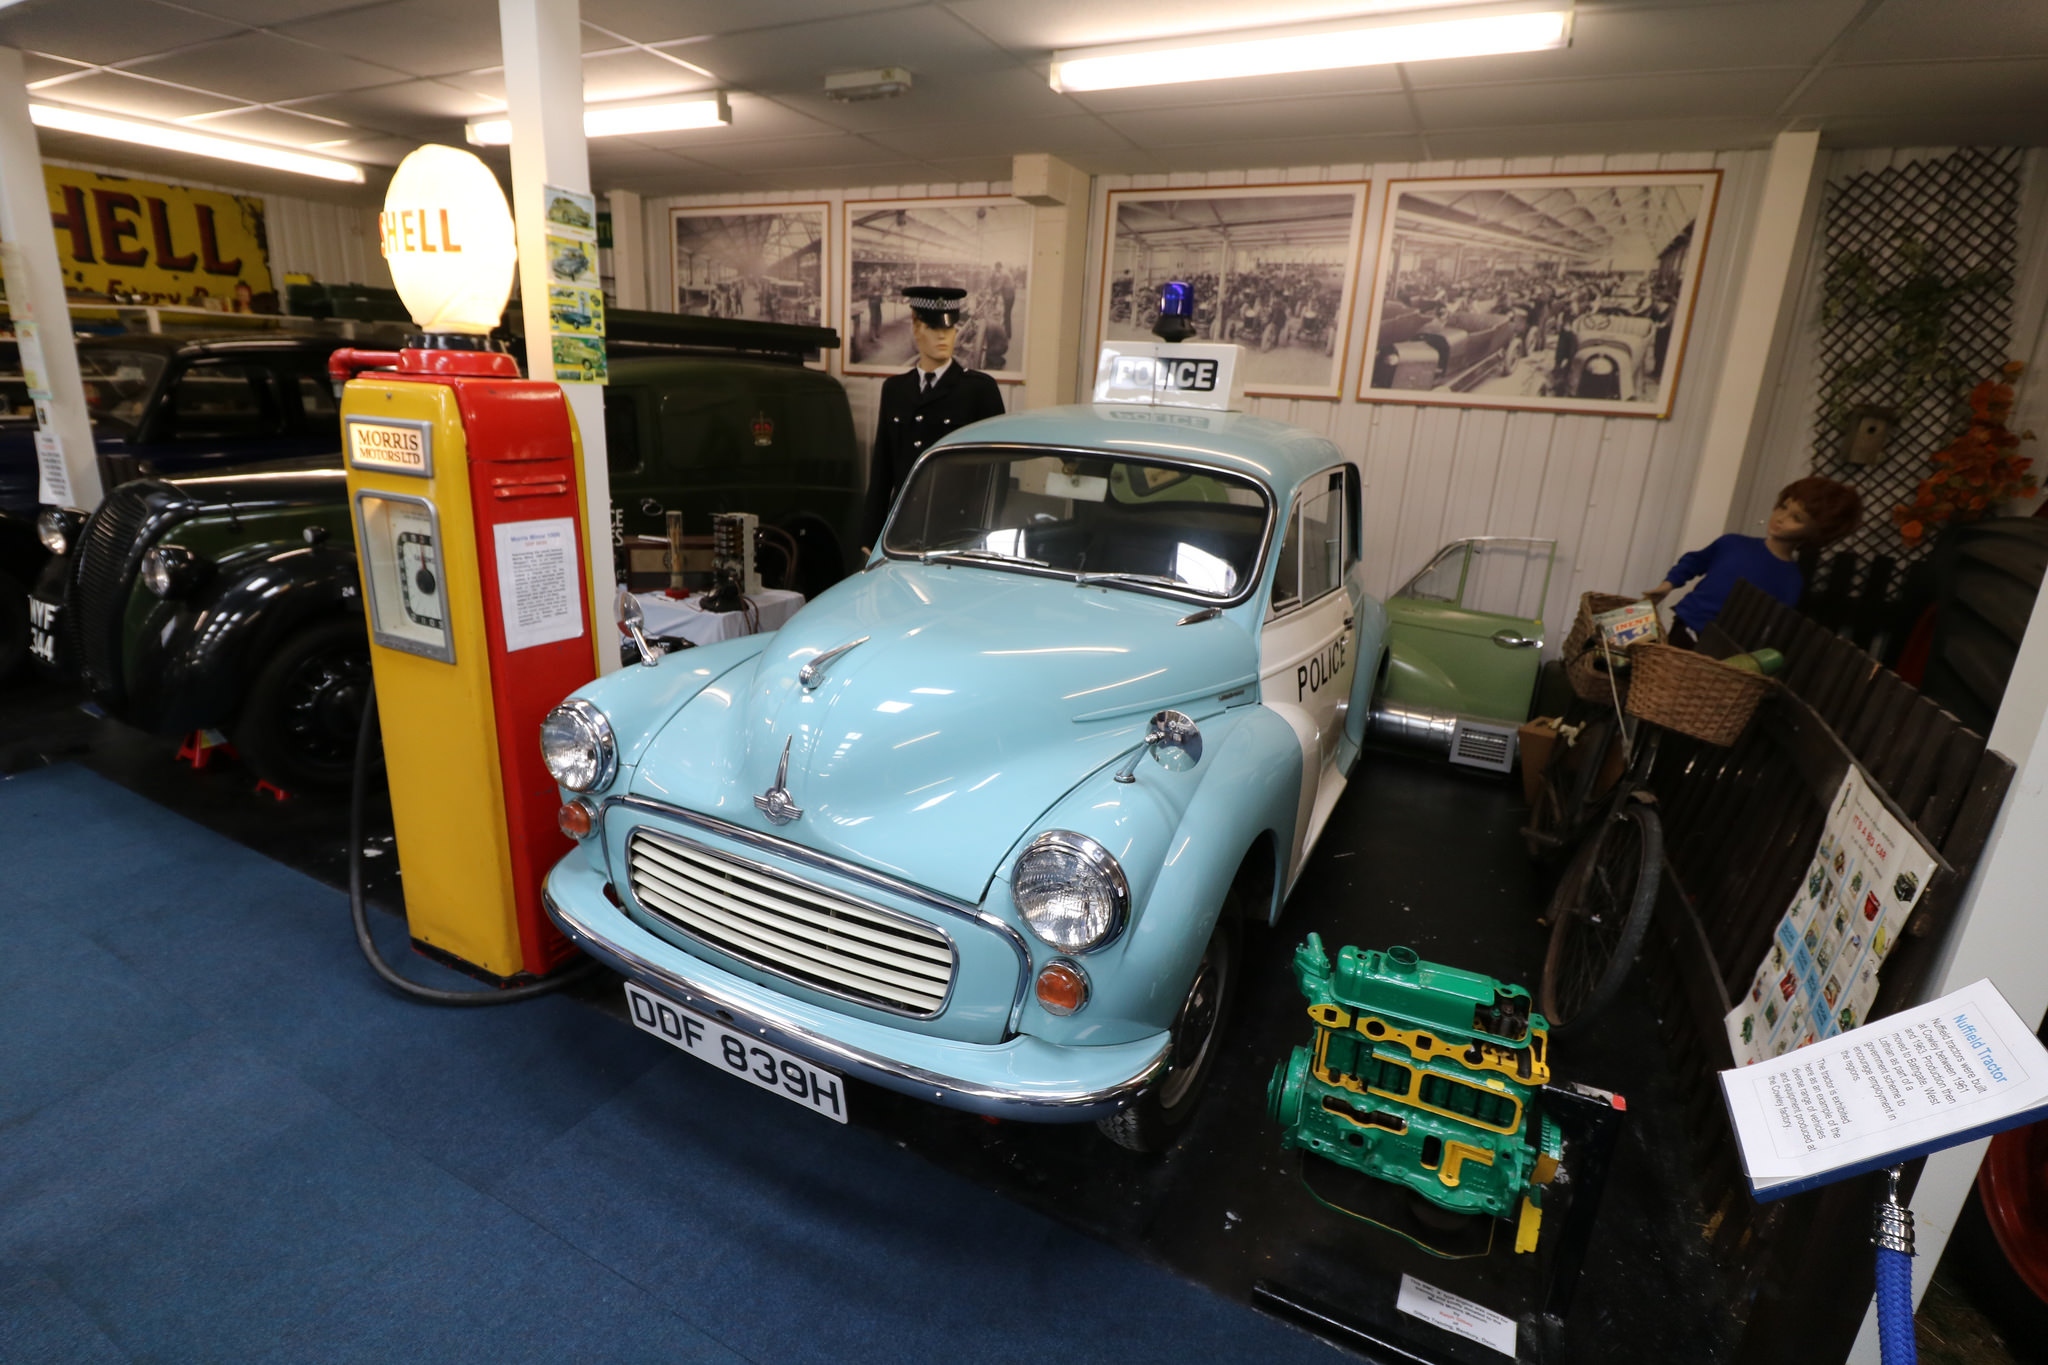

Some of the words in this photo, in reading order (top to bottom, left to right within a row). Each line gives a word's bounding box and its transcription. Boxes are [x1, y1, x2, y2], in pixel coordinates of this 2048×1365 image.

[52, 184, 241, 276] HELL
[1115, 359, 1214, 389] POLICE
[357, 429, 419, 451] MORRIS
[1298, 636, 1346, 703] POLICE
[630, 990, 704, 1048] DDF
[720, 1034, 841, 1116] 839H
[1840, 1050, 1851, 1060] the
[1878, 1036, 1896, 1058] Lothian
[1931, 1018, 1953, 1041] Nuffield
[1945, 1039, 1966, 1063] tractors
[1960, 1062, 1976, 1079] were
[1970, 1078, 1988, 1094] built
[1952, 1014, 1986, 1049] Nuffield
[1977, 1047, 2008, 1083] Tractor
[1804, 1062, 1815, 1077] here
[1816, 1058, 1826, 1071] The
[1889, 1057, 1900, 1066] as
[1892, 1032, 1910, 1052] moved
[1902, 1051, 1912, 1059] to
[1924, 1086, 1942, 1106] West
[1892, 1065, 1908, 1079] part
[1904, 1028, 1919, 1040] and
[1921, 1054, 1947, 1088] Production
[1941, 1088, 1957, 1105] then
[1922, 1029, 1940, 1051] Cowley
[1935, 1050, 1958, 1077] between
[1952, 1076, 1970, 1094] 1961
[1768, 1075, 1777, 1086] the
[1779, 1072, 1791, 1084] and
[1792, 1068, 1806, 1088] diverse
[1809, 1076, 1818, 1085] as
[1820, 1070, 1835, 1090] tractor
[1852, 1046, 1874, 1076] encourage
[1868, 1075, 1895, 1114] employment
[1887, 1112, 1898, 1122] in
[1863, 1041, 1890, 1075] government
[1882, 1074, 1902, 1100] scheme
[1896, 1098, 1906, 1107] to
[1901, 1078, 1914, 1086] of
[1771, 1085, 1785, 1107] Cowley
[1784, 1083, 1803, 1114] equipment
[1800, 1088, 1813, 1106] range
[1812, 1084, 1822, 1094] an
[1829, 1088, 1839, 1096] is
[1806, 1105, 1818, 1113] of
[1816, 1093, 1834, 1120] example
[1832, 1096, 1852, 1125] exhibited
[1793, 1113, 1815, 1144] produced
[1810, 1112, 1827, 1140] vehicles
[1827, 1120, 1839, 1128] of
[1830, 1126, 1841, 1139] the
[1806, 1144, 1818, 1152] at
